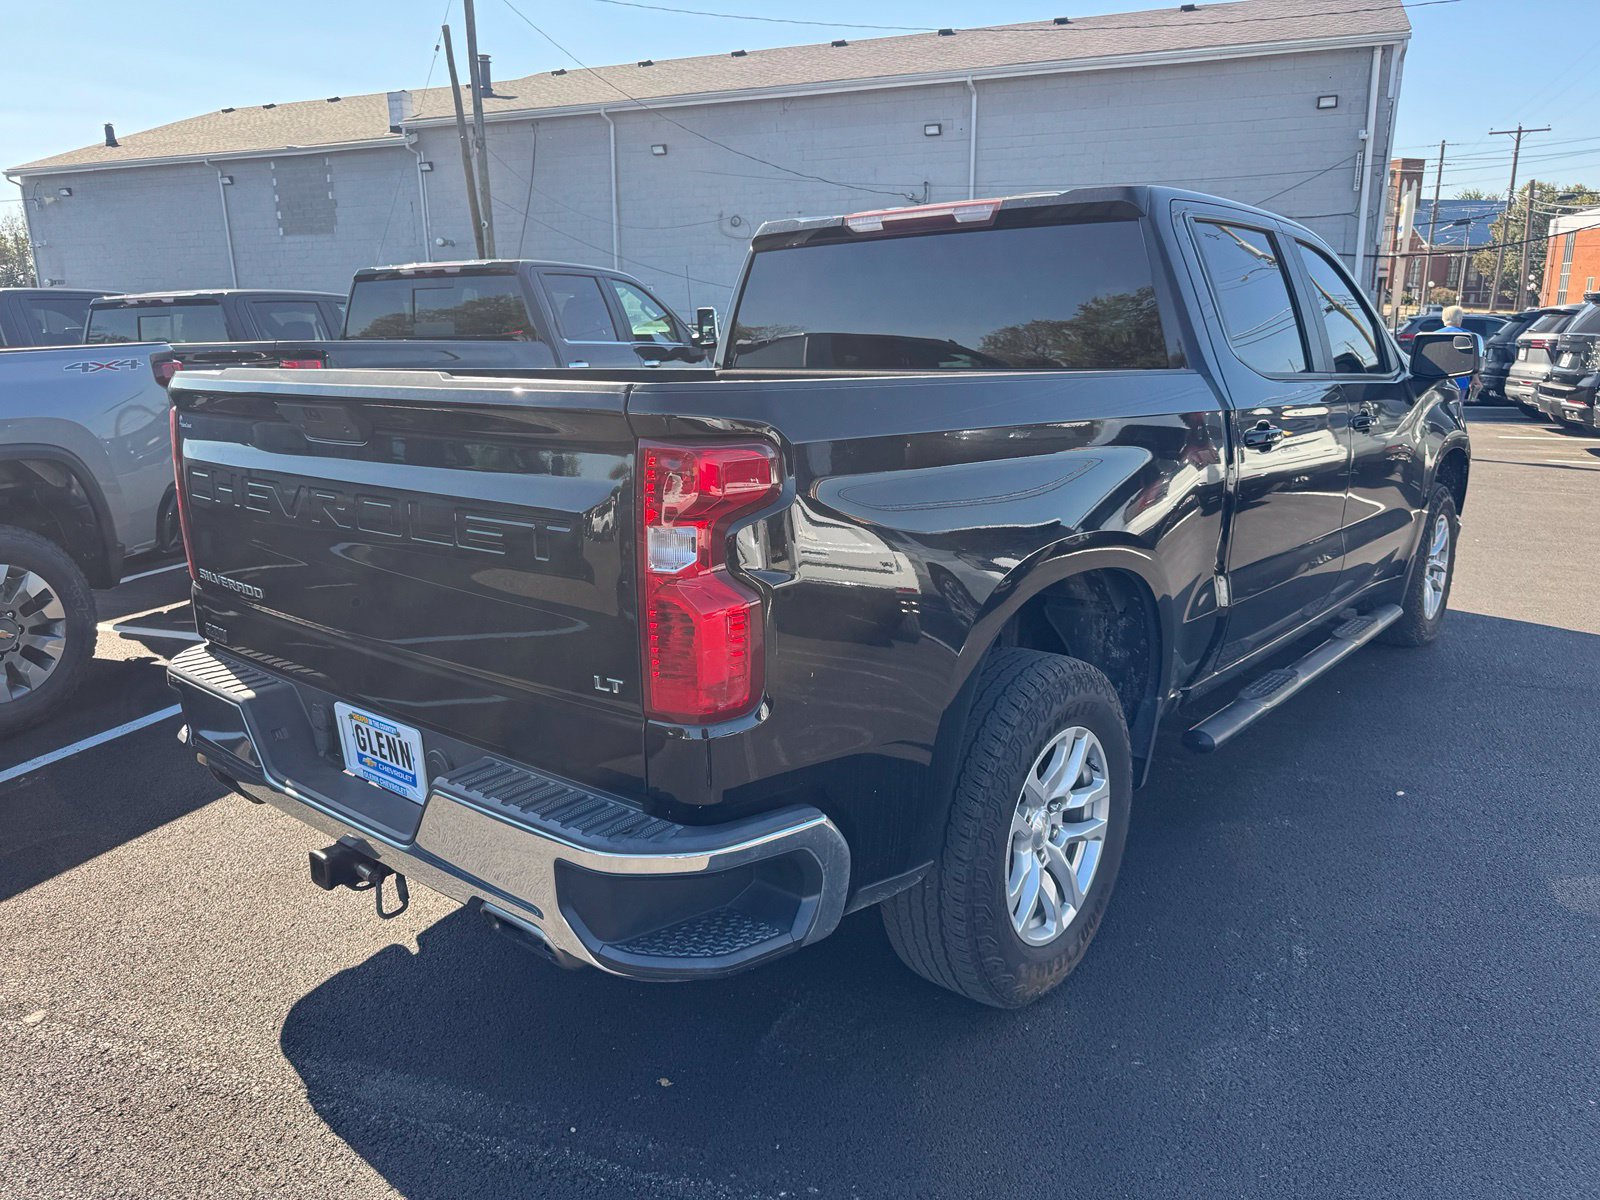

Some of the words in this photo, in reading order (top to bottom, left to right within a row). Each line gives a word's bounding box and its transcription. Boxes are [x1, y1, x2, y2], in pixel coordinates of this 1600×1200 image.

[188, 466, 573, 562] CHEVROLET
[198, 567, 264, 599] SILVERADO
[593, 674, 624, 694] LT
[354, 723, 413, 771] GLENN
[378, 763, 413, 783] CHEVROLET
[379, 778, 407, 795] CHEVROLET
